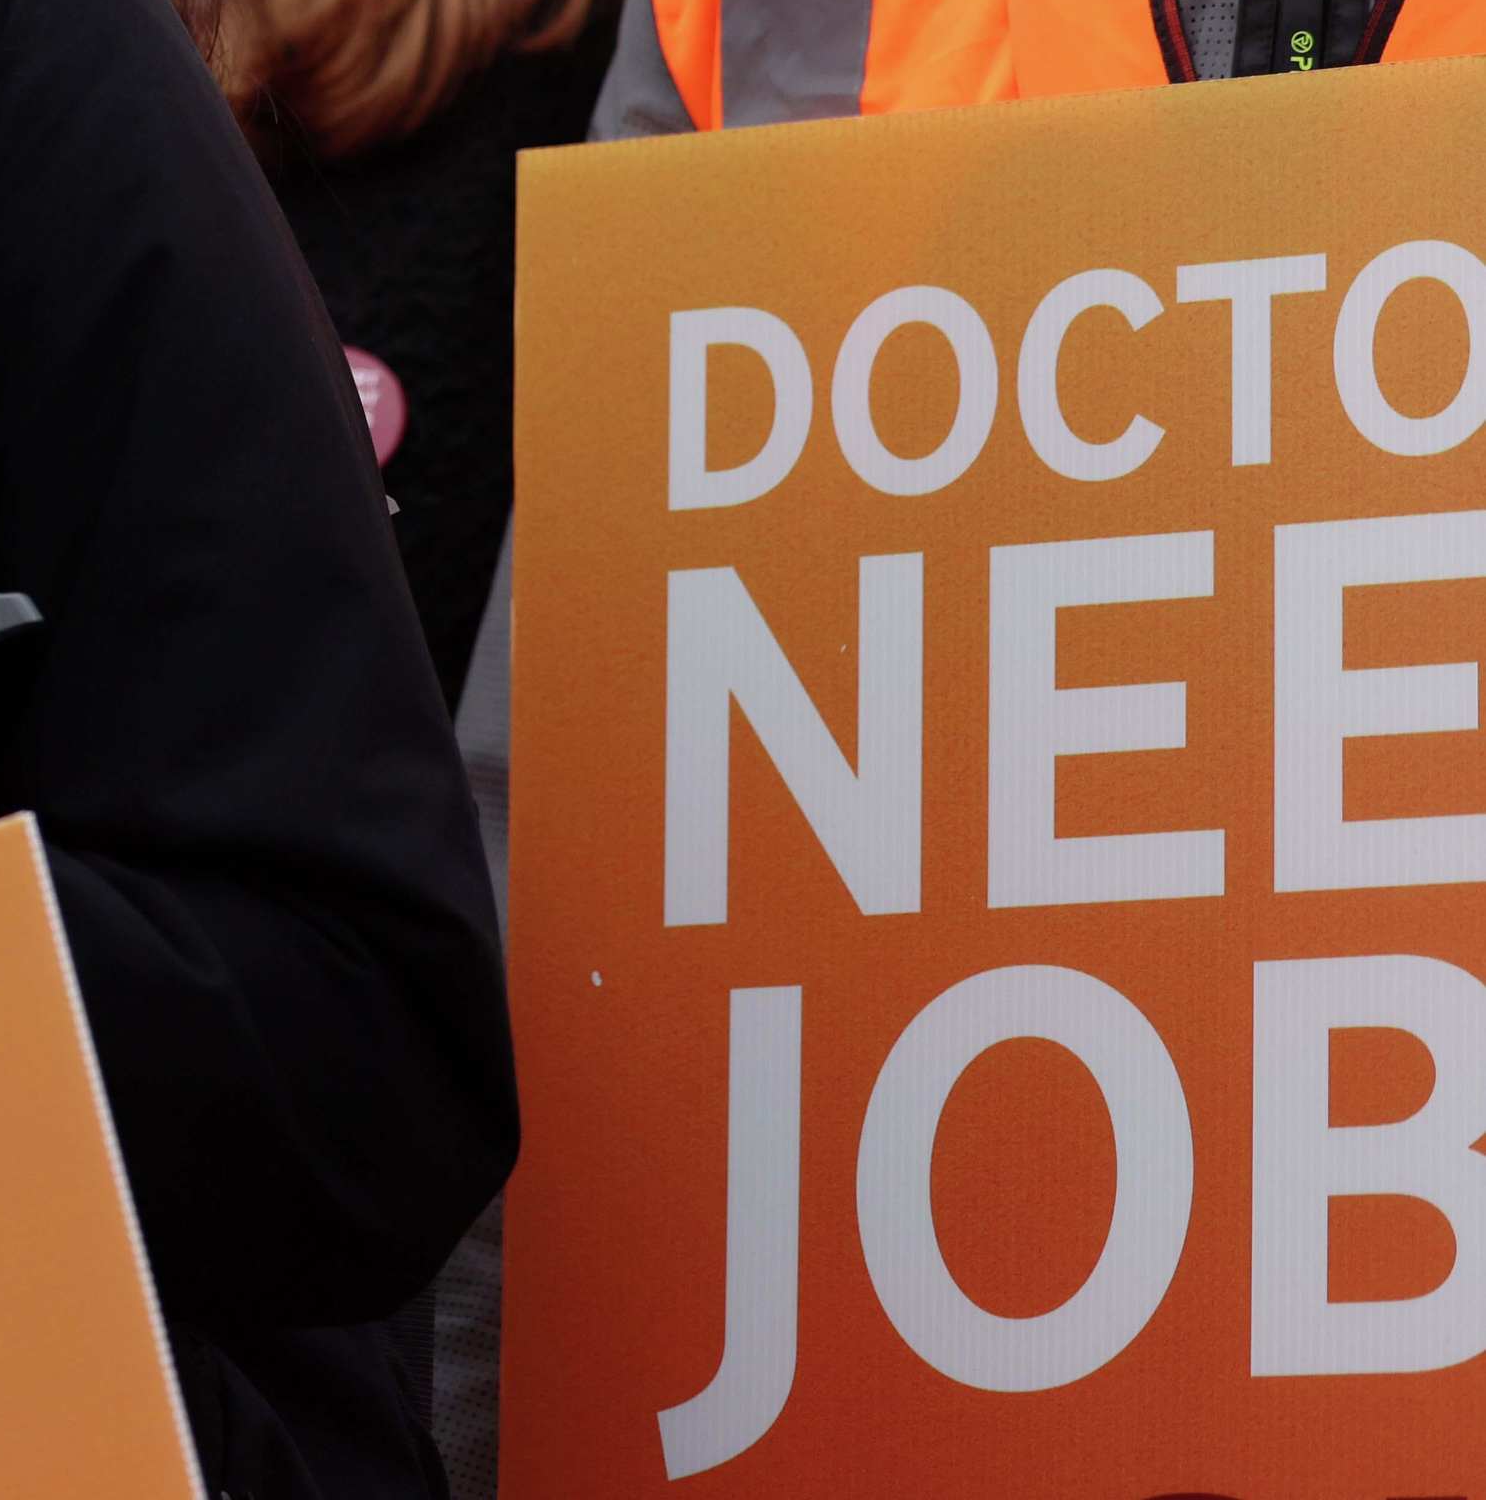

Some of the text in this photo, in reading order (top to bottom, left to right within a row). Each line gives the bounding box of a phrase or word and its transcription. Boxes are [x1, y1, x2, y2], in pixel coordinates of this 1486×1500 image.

[668, 239, 1486, 512] DOCTO
[663, 509, 1486, 928] NEE
[656, 953, 1486, 1483] JOB
